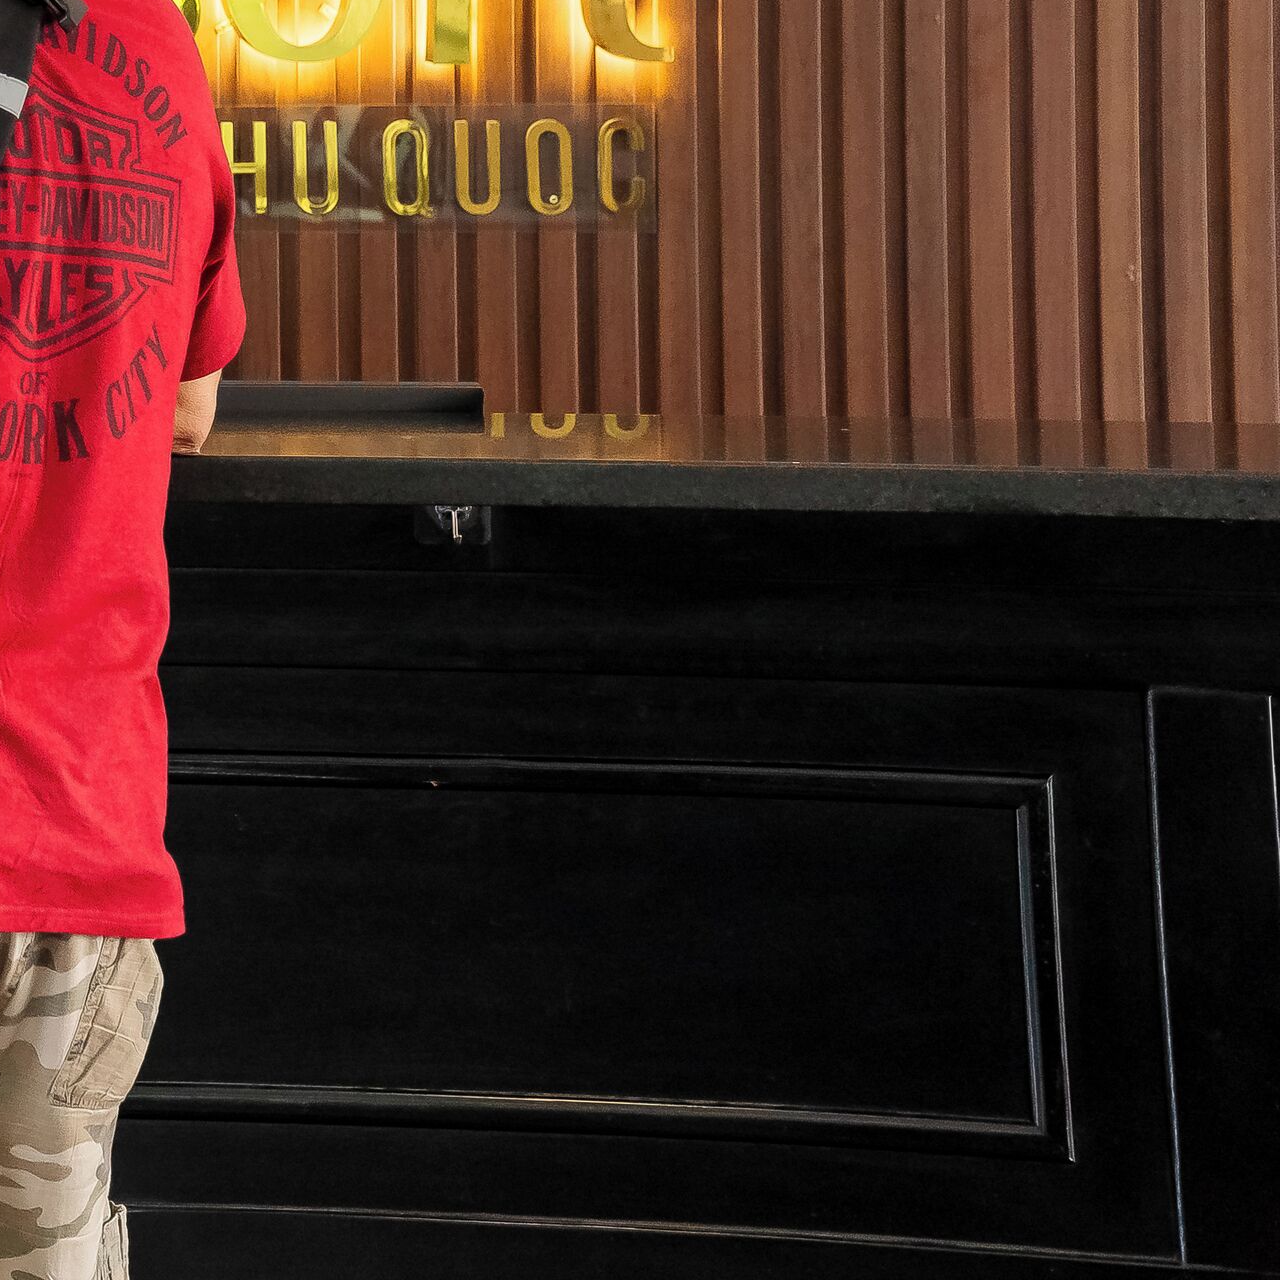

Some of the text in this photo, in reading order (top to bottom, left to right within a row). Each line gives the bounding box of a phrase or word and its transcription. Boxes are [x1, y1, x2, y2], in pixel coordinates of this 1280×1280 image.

[220, 118, 645, 218] HU QUOC
[19, 370, 48, 395] OF
[104, 322, 168, 441] CITY
